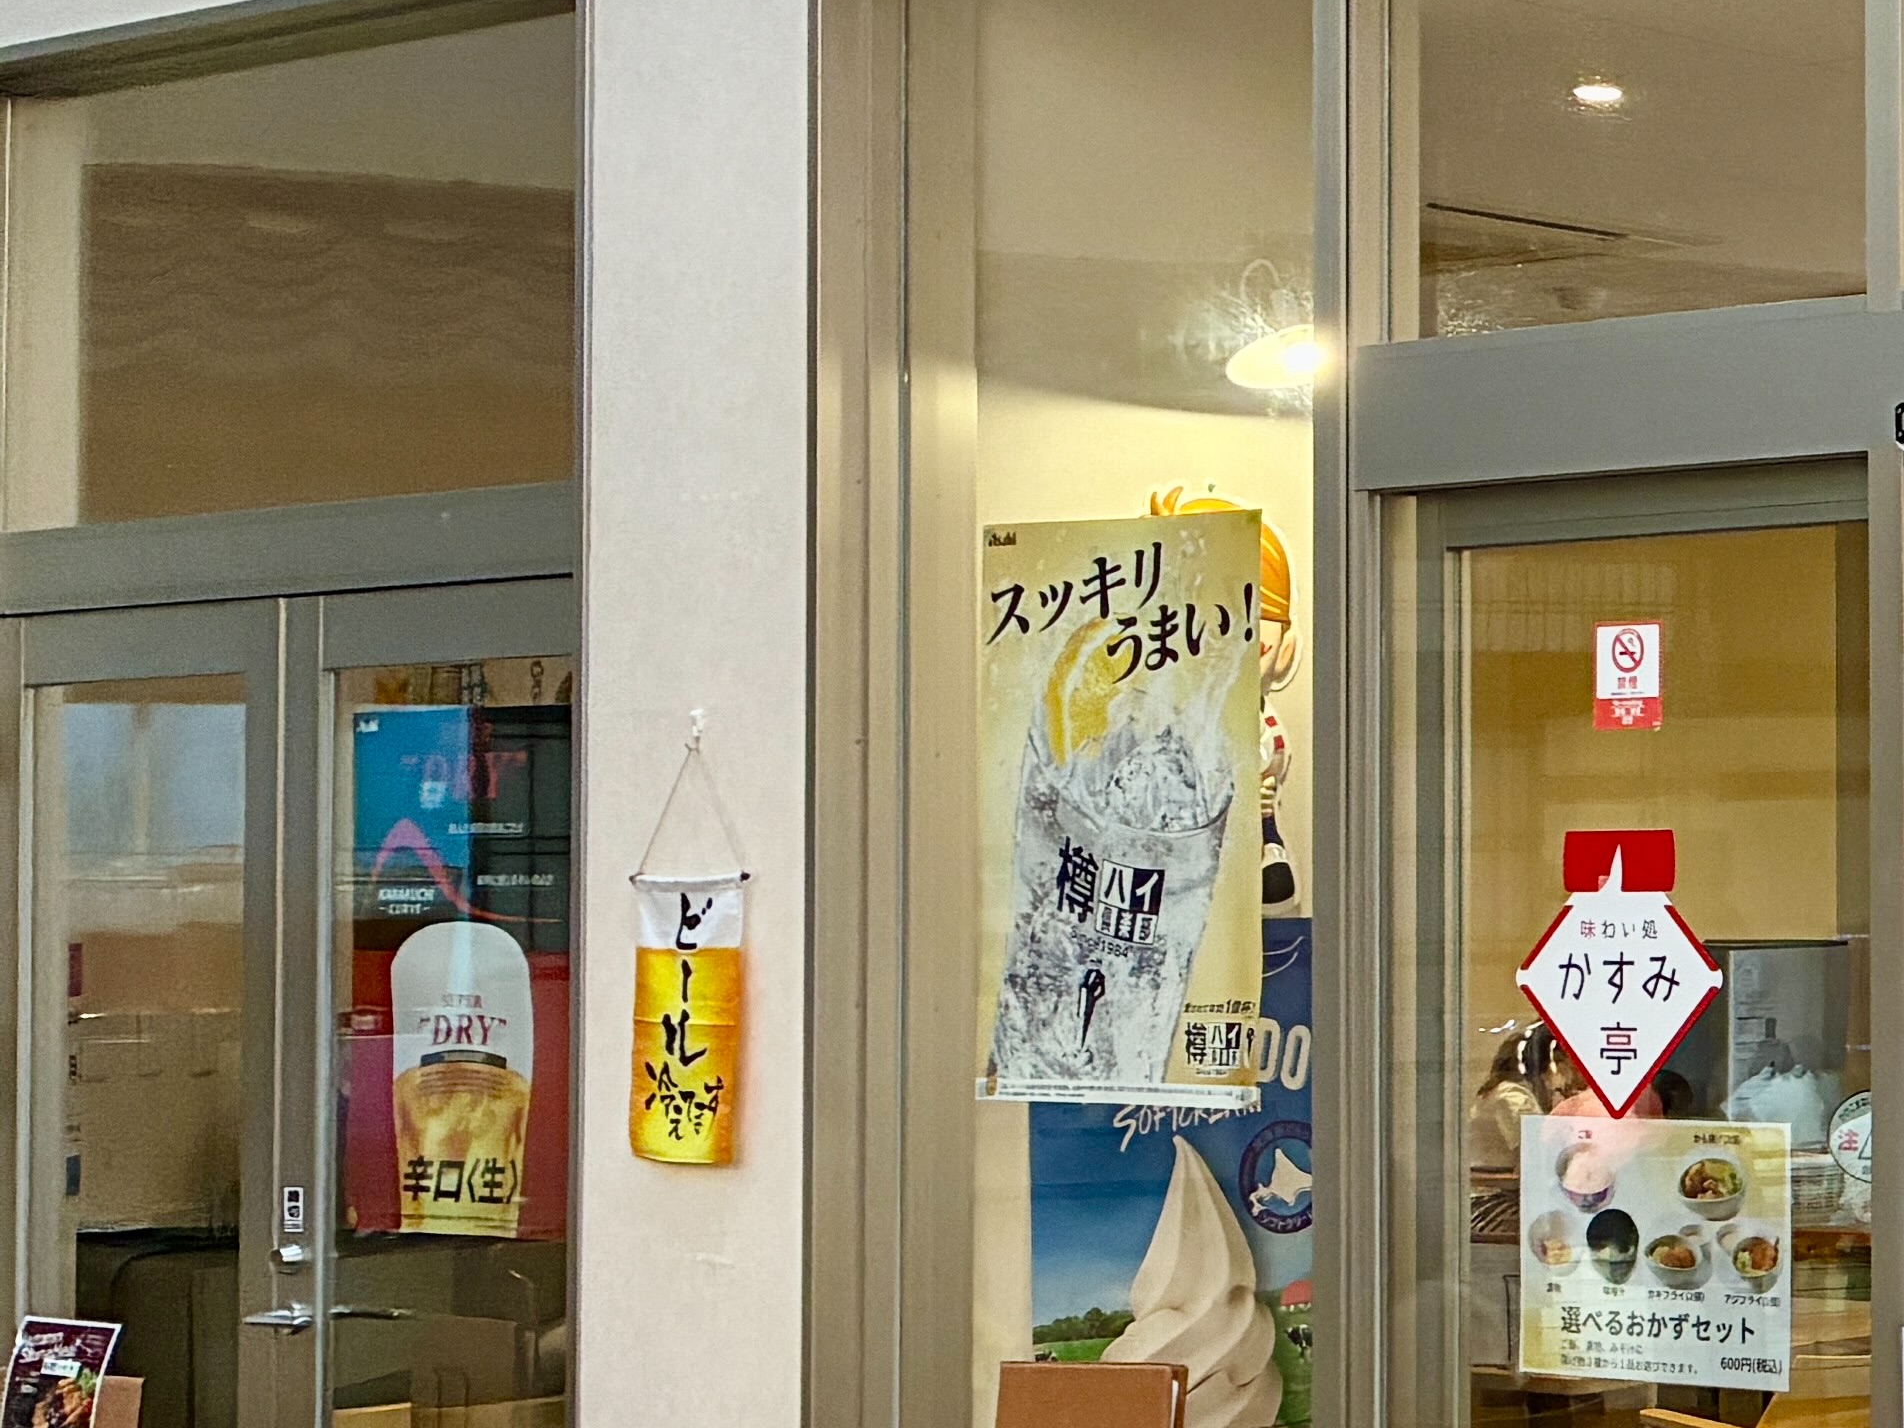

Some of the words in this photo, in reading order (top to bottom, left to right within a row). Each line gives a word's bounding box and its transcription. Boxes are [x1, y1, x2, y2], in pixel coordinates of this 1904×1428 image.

[985, 541, 1162, 645] スッキリ
[1106, 582, 1254, 685] うまい!
[1580, 919, 1659, 941] 味わい処
[676, 891, 714, 1068] ビール
[1558, 951, 1681, 1005] かすみ
[1599, 1021, 1638, 1076] 亭
[1560, 1305, 1756, 1345] 選べるおかずセット
